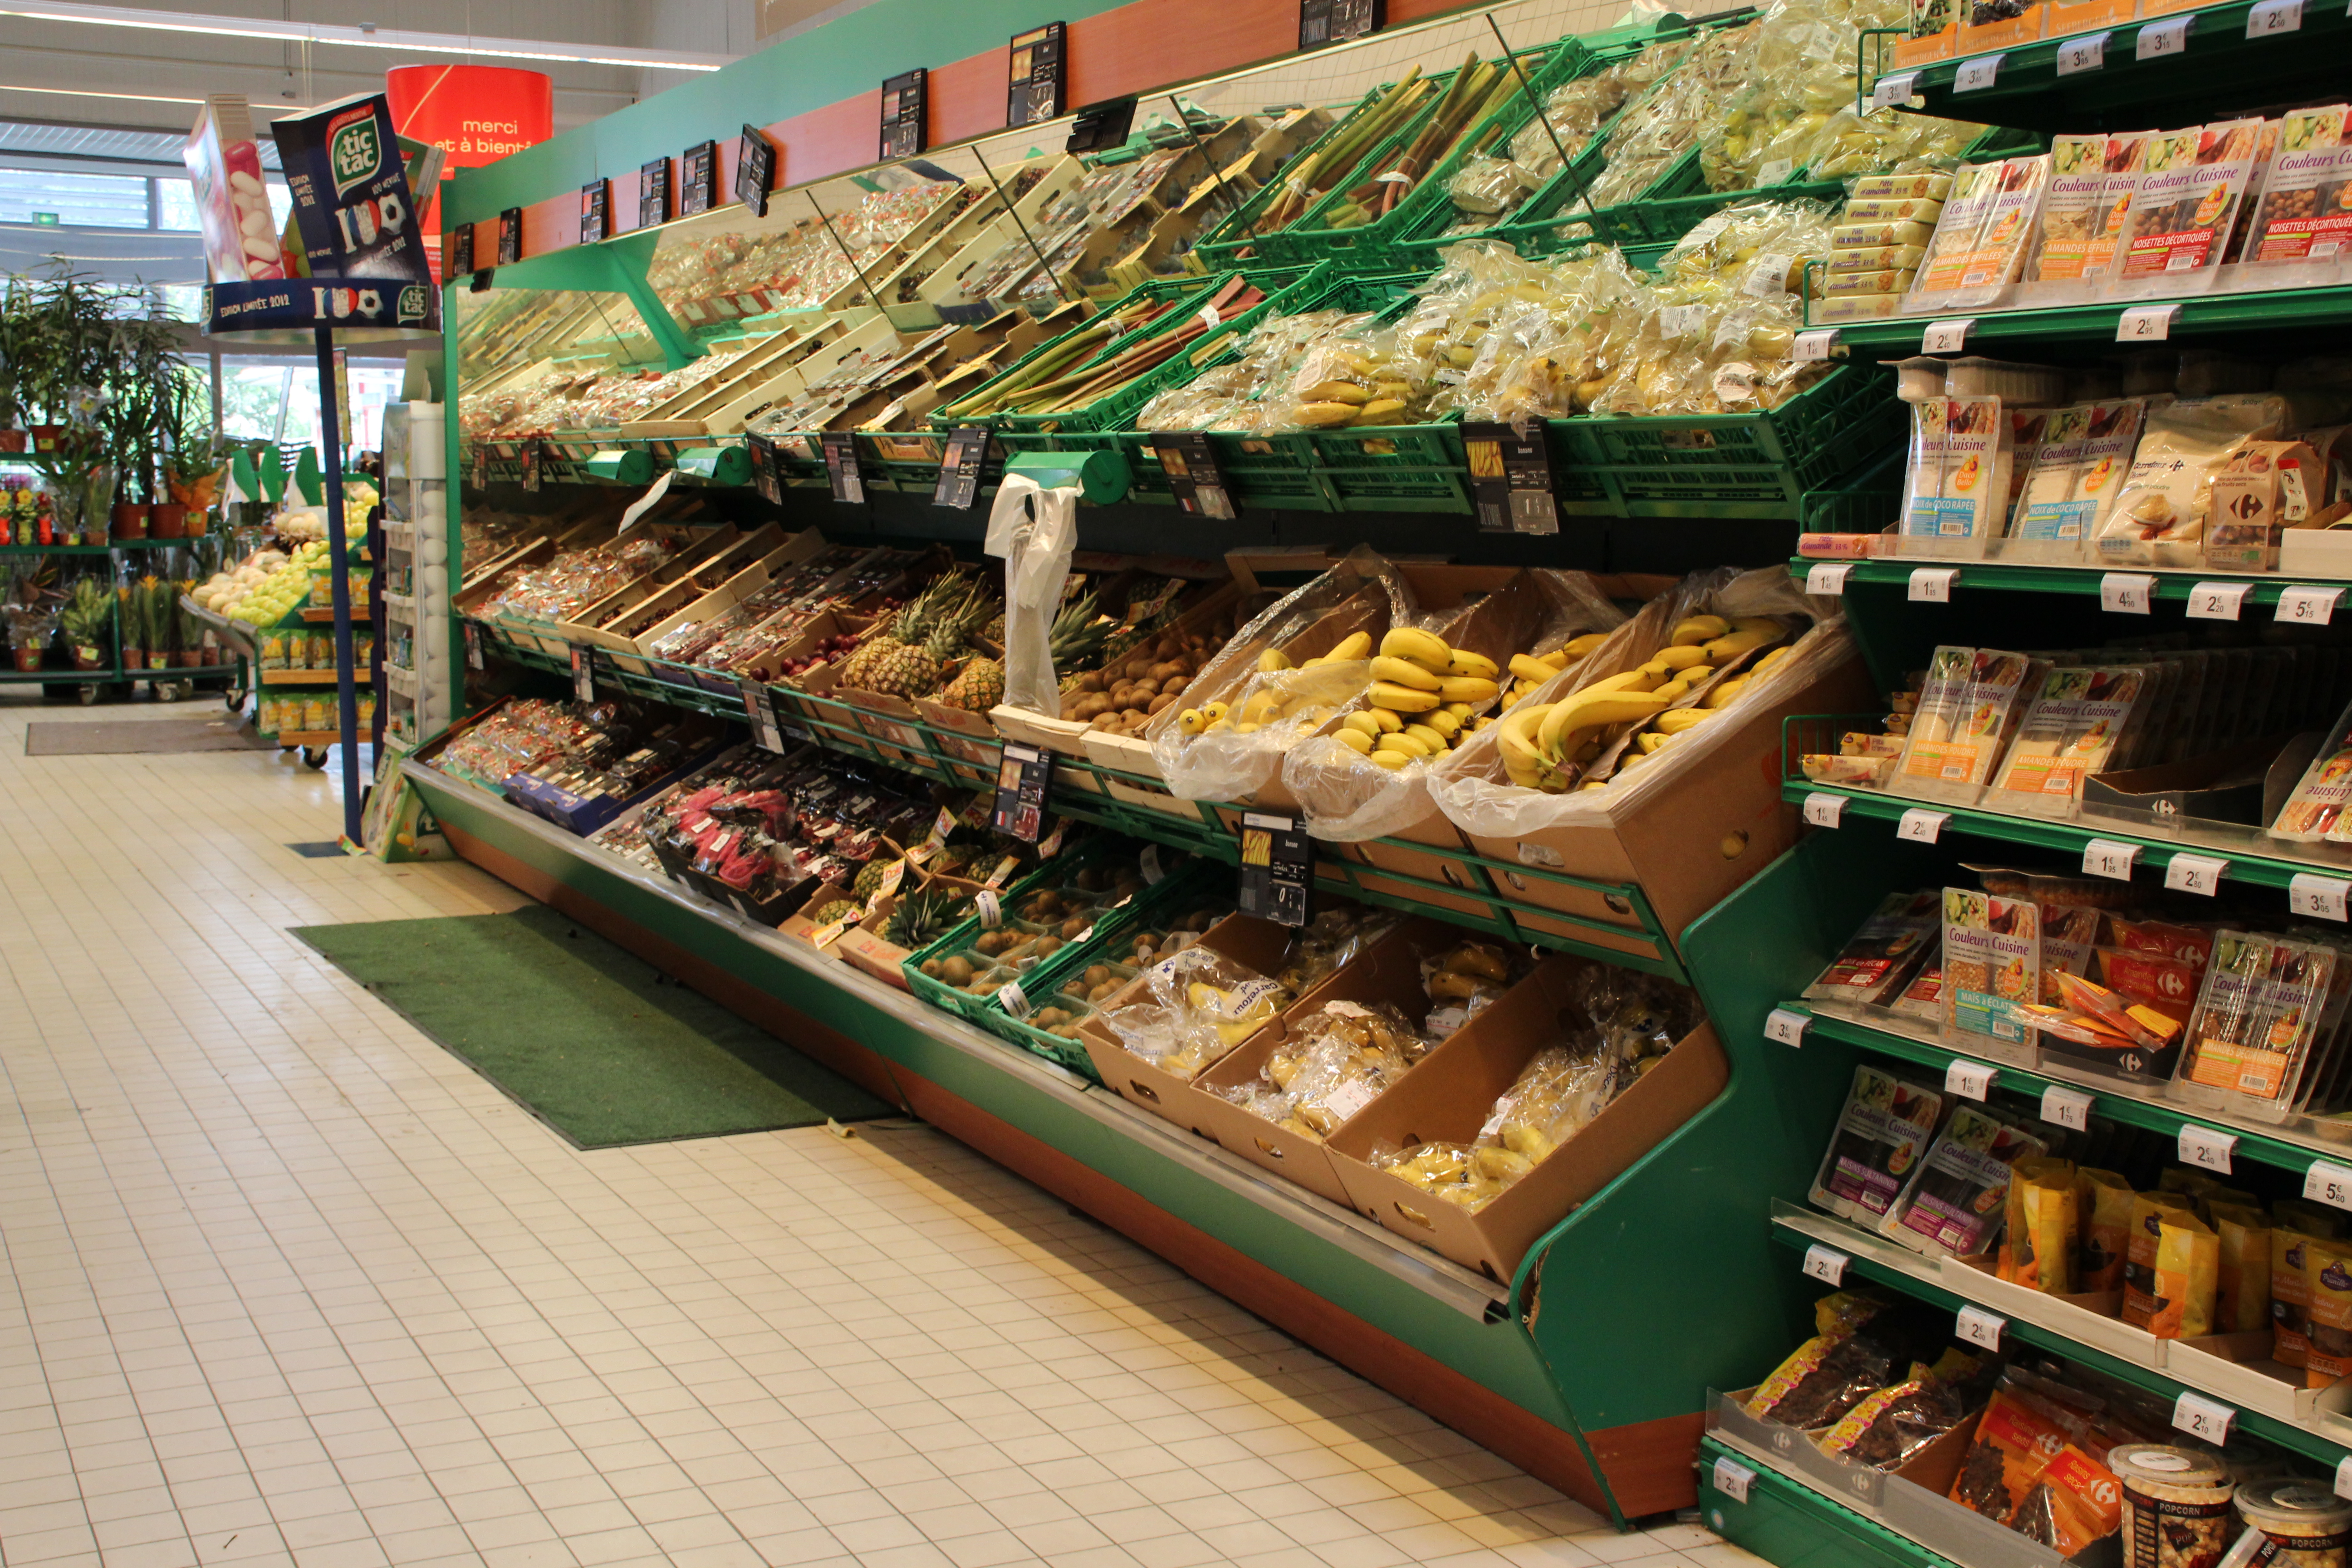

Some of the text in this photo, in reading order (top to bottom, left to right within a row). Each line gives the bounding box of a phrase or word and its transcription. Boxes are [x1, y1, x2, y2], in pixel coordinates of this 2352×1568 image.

[2057, 15, 2109, 34] SEEBERGER
[1967, 31, 2014, 49] SEEBERGER
[1900, 52, 1939, 66] SEEBERGER
[462, 120, 518, 135] merci
[342, 129, 372, 156] tic
[434, 137, 471, 152] et à
[340, 149, 375, 176] tac
[2278, 153, 2335, 171] Couleurs
[2052, 177, 2099, 192] Couleurs
[2142, 167, 2239, 191] Couleurs Cuisine
[299, 194, 315, 207] 2012
[2200, 201, 2220, 210] Daco
[2197, 210, 2215, 218] Bello
[1997, 223, 2014, 231] Daco
[2269, 221, 2306, 233] NOISETTES
[2132, 230, 2212, 249] NOISETTES DÉCORTIQUÉES
[2047, 244, 2086, 252] AMANDES
[1935, 250, 2003, 266] AMANDES EFFILÉES
[408, 289, 425, 303] tic
[220, 294, 290, 317] EDITION LIMITÉE 2012
[404, 301, 425, 314] tac
[1948, 440, 1986, 452] Cuisine
[2041, 441, 2123, 460] Couleurs Cuisine
[2133, 461, 2167, 470] Carrefour
[1958, 470, 1975, 479] Daco
[2090, 472, 2107, 480] Daco
[1933, 500, 1951, 510] COCO
[1951, 499, 1975, 510] RÂPÉE
[2029, 505, 2046, 514] NOIX
[2055, 503, 2073, 513] COCO
[2073, 500, 2097, 513] RÂPÉE
[1967, 686, 2005, 701] Cuisine
[2036, 701, 2121, 717] Couleurs Cuisine
[1916, 743, 1976, 757] AMANDES POUDRE
[2019, 756, 2087, 768] AMANDES POUDRE
[1285, 839, 1298, 848] banane
[1949, 928, 2029, 955] Couleurs Cuisine
[1865, 958, 1886, 967] PÉCAN
[2005, 973, 2021, 982] Daco
[2124, 966, 2155, 981] Amandes
[2004, 980, 2019, 989] Bello
[1233, 982, 1278, 1015] Carrefour
[1961, 992, 1980, 1004] MAÏS
[2271, 1030, 2289, 1040] Bello
[2274, 1023, 2294, 1033] Daco
[2203, 1041, 2285, 1066] AMANDES DÉCORTIQUÉES
[1851, 1103, 1922, 1142] Couleurs Cuisine
[1940, 1142, 1982, 1167] Couleurs
[1839, 1157, 1897, 1188] RAISINS SULTANINES
[1919, 1193, 1943, 1210] RAISINS
[2008, 1414, 2035, 1436] Raisins
[2011, 1431, 2030, 1448] secs
[2068, 1459, 2091, 1480] Raisins
[2063, 1472, 2082, 1490] secs
[2078, 1493, 2109, 1519] Carrefour
[2159, 1503, 2201, 1516] POPCORN
[2176, 1533, 2193, 1546] POP
[2291, 1539, 2333, 1548] POPCORN
